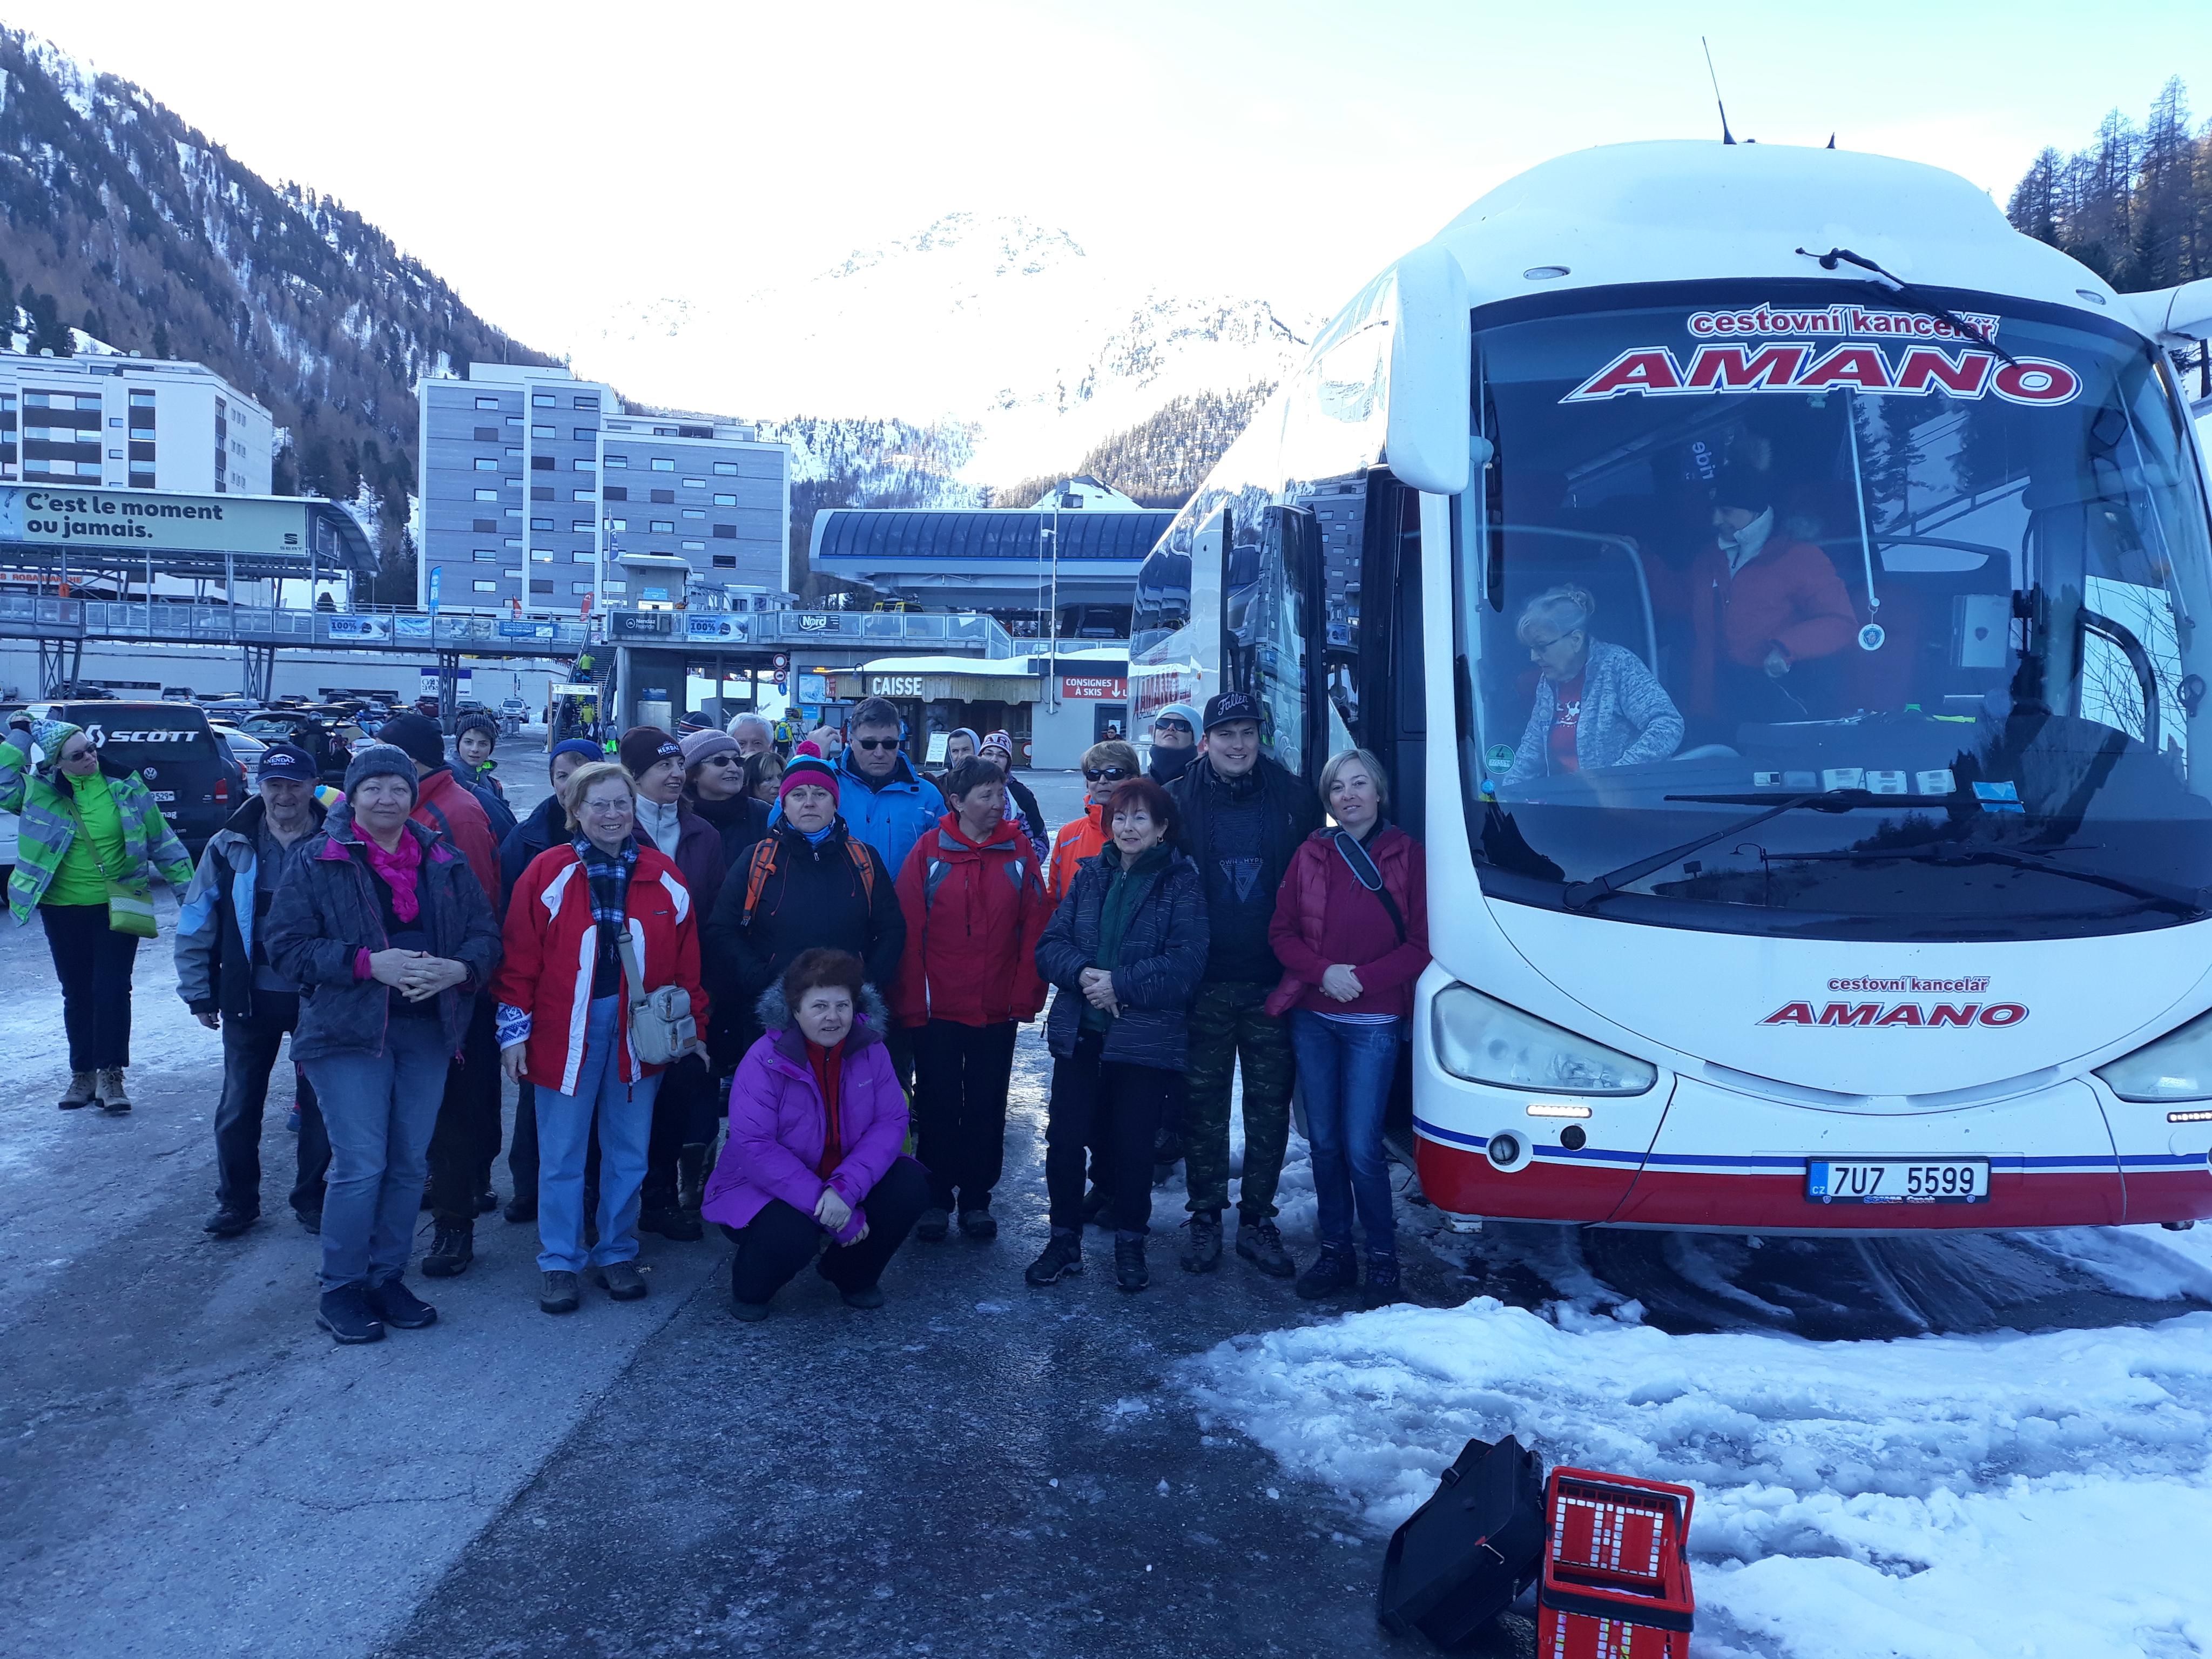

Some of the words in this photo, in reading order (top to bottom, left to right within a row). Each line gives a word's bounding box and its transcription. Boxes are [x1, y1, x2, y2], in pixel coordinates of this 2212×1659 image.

[1691, 306, 1844, 335] cestovní
[1566, 343, 2079, 404] AMANO
[25, 492, 87, 513] C'est
[92, 496, 116, 515] le
[122, 502, 222, 520] moment
[27, 518, 58, 533] ou
[62, 515, 153, 538] jamais.
[691, 623, 716, 631] 100%
[802, 616, 826, 626] Nord
[873, 677, 922, 696] CAISSE
[1065, 678, 1111, 687] CONSIGNES
[1075, 686, 1081, 696] À
[1084, 688, 1102, 696] SKIS
[1218, 694, 1249, 716] Fallen
[109, 731, 199, 742] SCOTT
[1829, 975, 1907, 992] cestovní
[1911, 976, 1990, 993] kancelář
[1759, 1001, 2028, 1028] AMANO
[1834, 1167, 1885, 1195] 7U7
[1907, 1167, 1974, 1195] 5599
